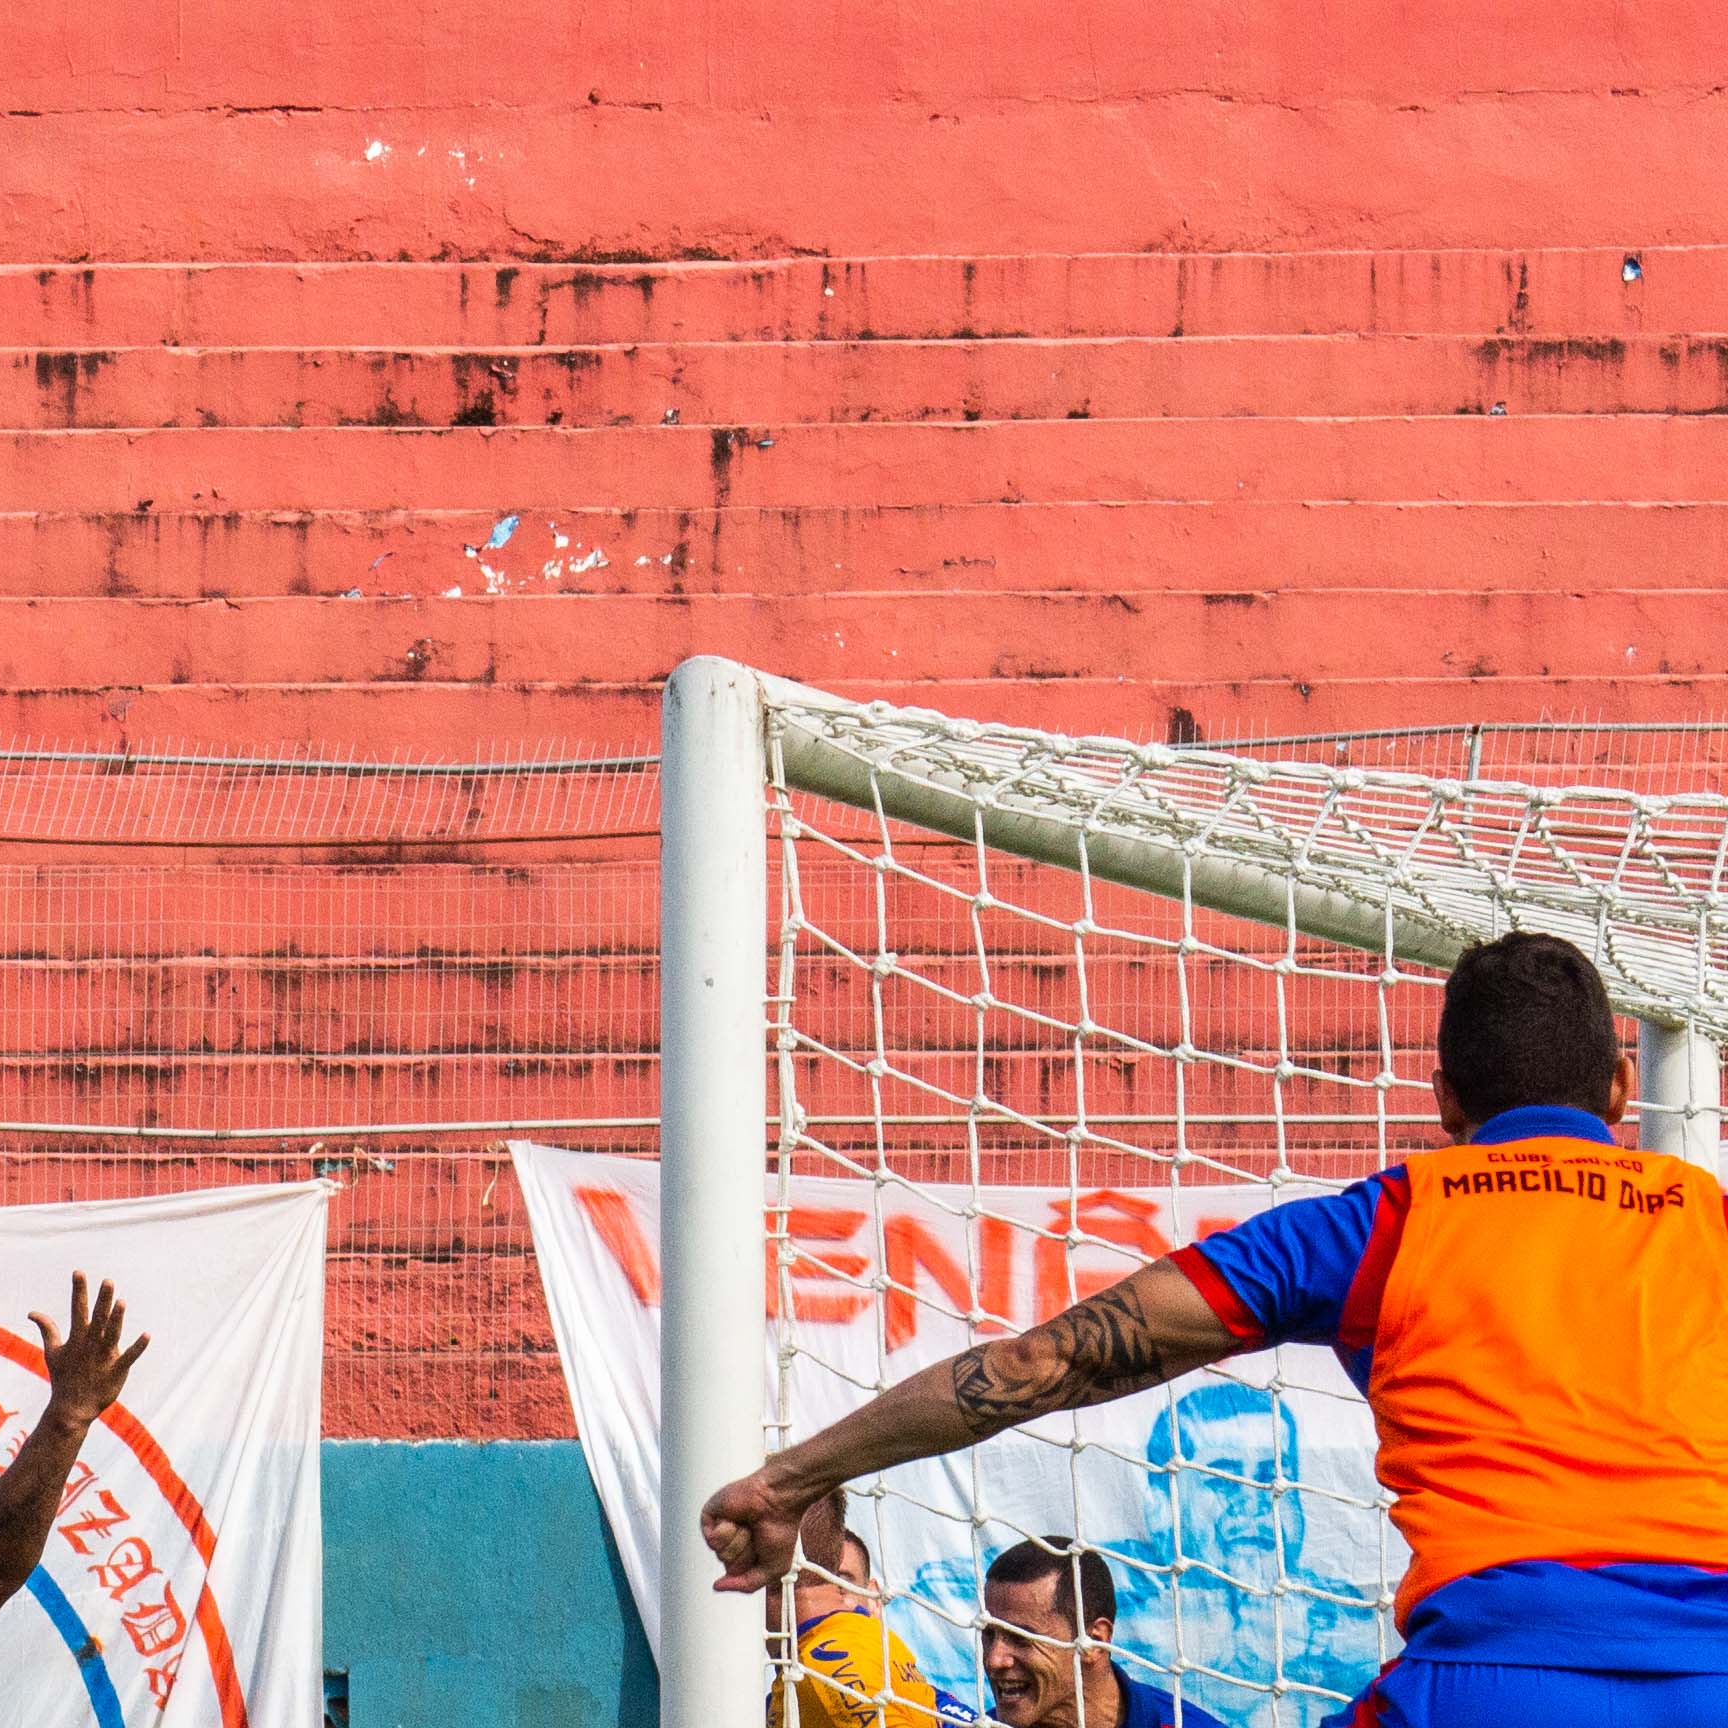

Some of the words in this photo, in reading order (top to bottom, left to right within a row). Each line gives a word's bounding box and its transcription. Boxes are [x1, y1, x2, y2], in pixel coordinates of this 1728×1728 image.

[1487, 1152, 1553, 1164] CLUBE
[1442, 1164, 1606, 1202] MARCÍLIO
[1619, 1180, 1685, 1215] DIAS
